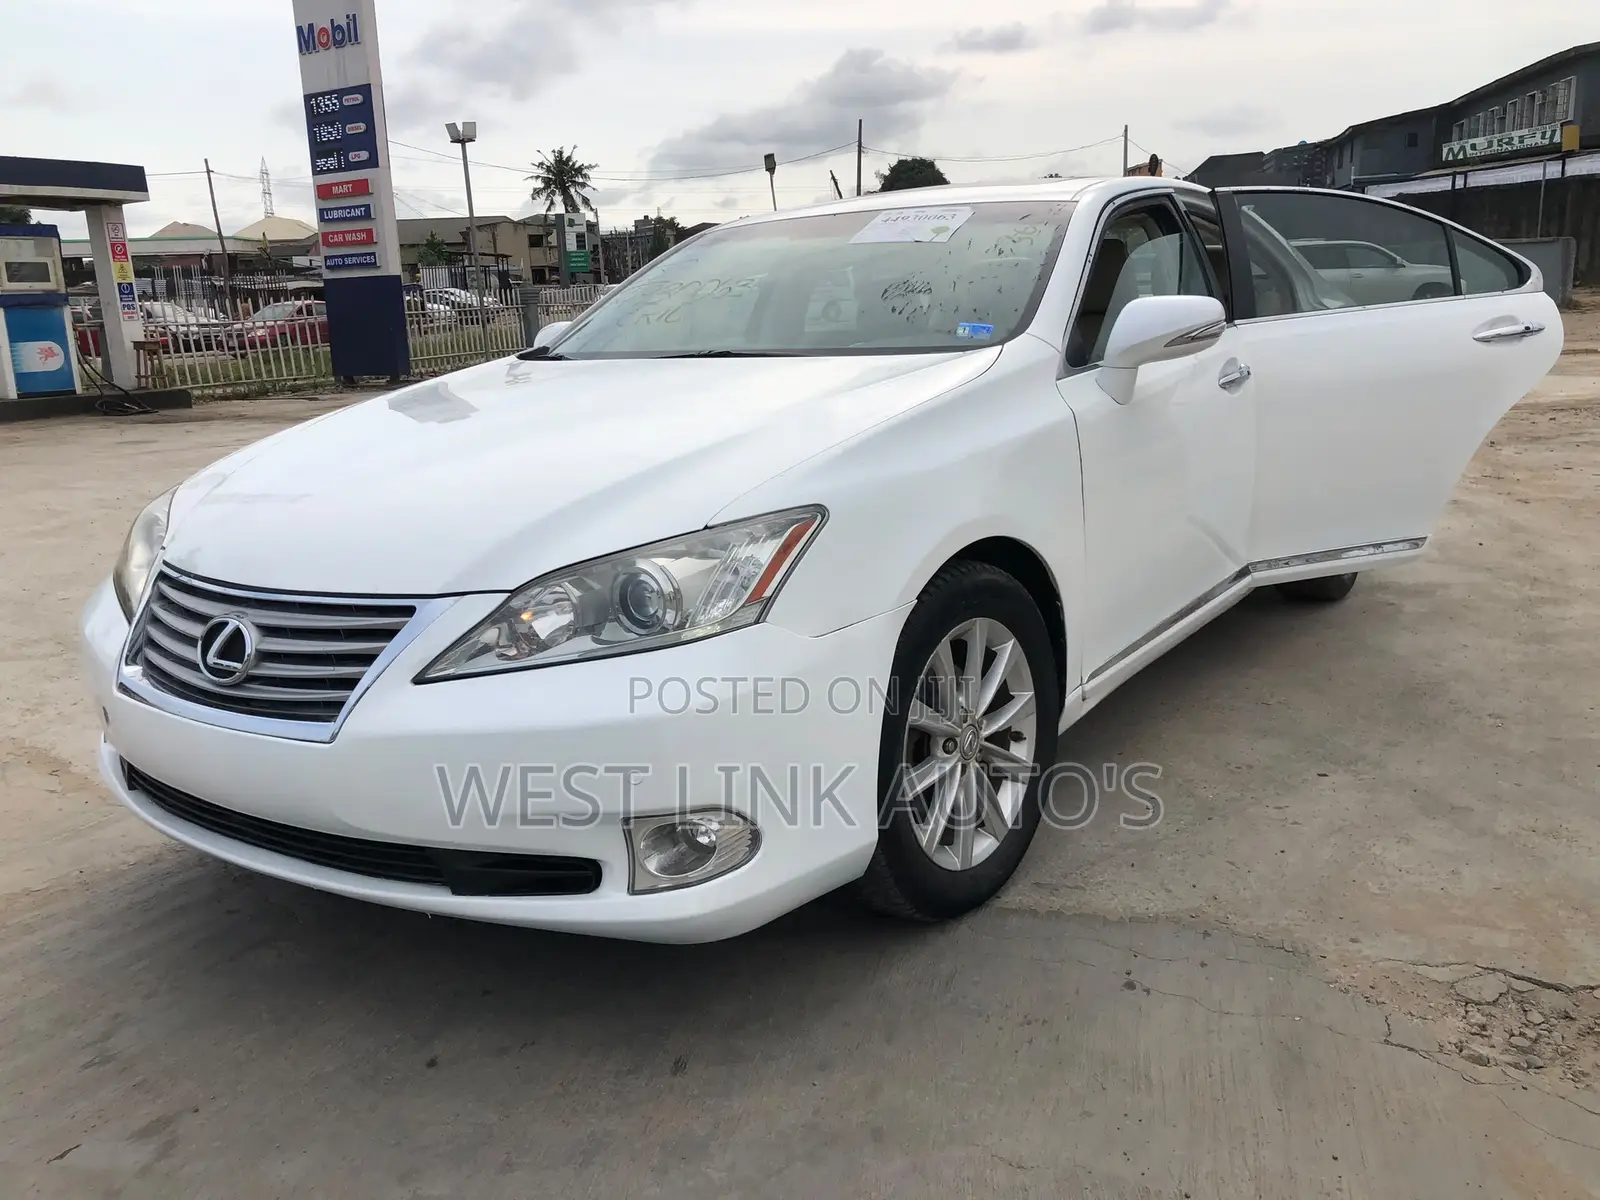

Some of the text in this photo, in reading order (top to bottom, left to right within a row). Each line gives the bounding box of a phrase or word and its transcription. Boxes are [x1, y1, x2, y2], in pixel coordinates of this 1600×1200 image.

[297, 13, 360, 54] Mobil
[310, 94, 340, 115] 1355
[344, 96, 361, 104] PETROL
[1469, 141, 1548, 157] INTERNATIONAL
[331, 184, 353, 195] MART
[323, 207, 366, 220] LUBRICANT
[328, 231, 367, 243] CAR WASH
[326, 255, 375, 266] AUTO SERVICES
[122, 303, 136, 311] POS
